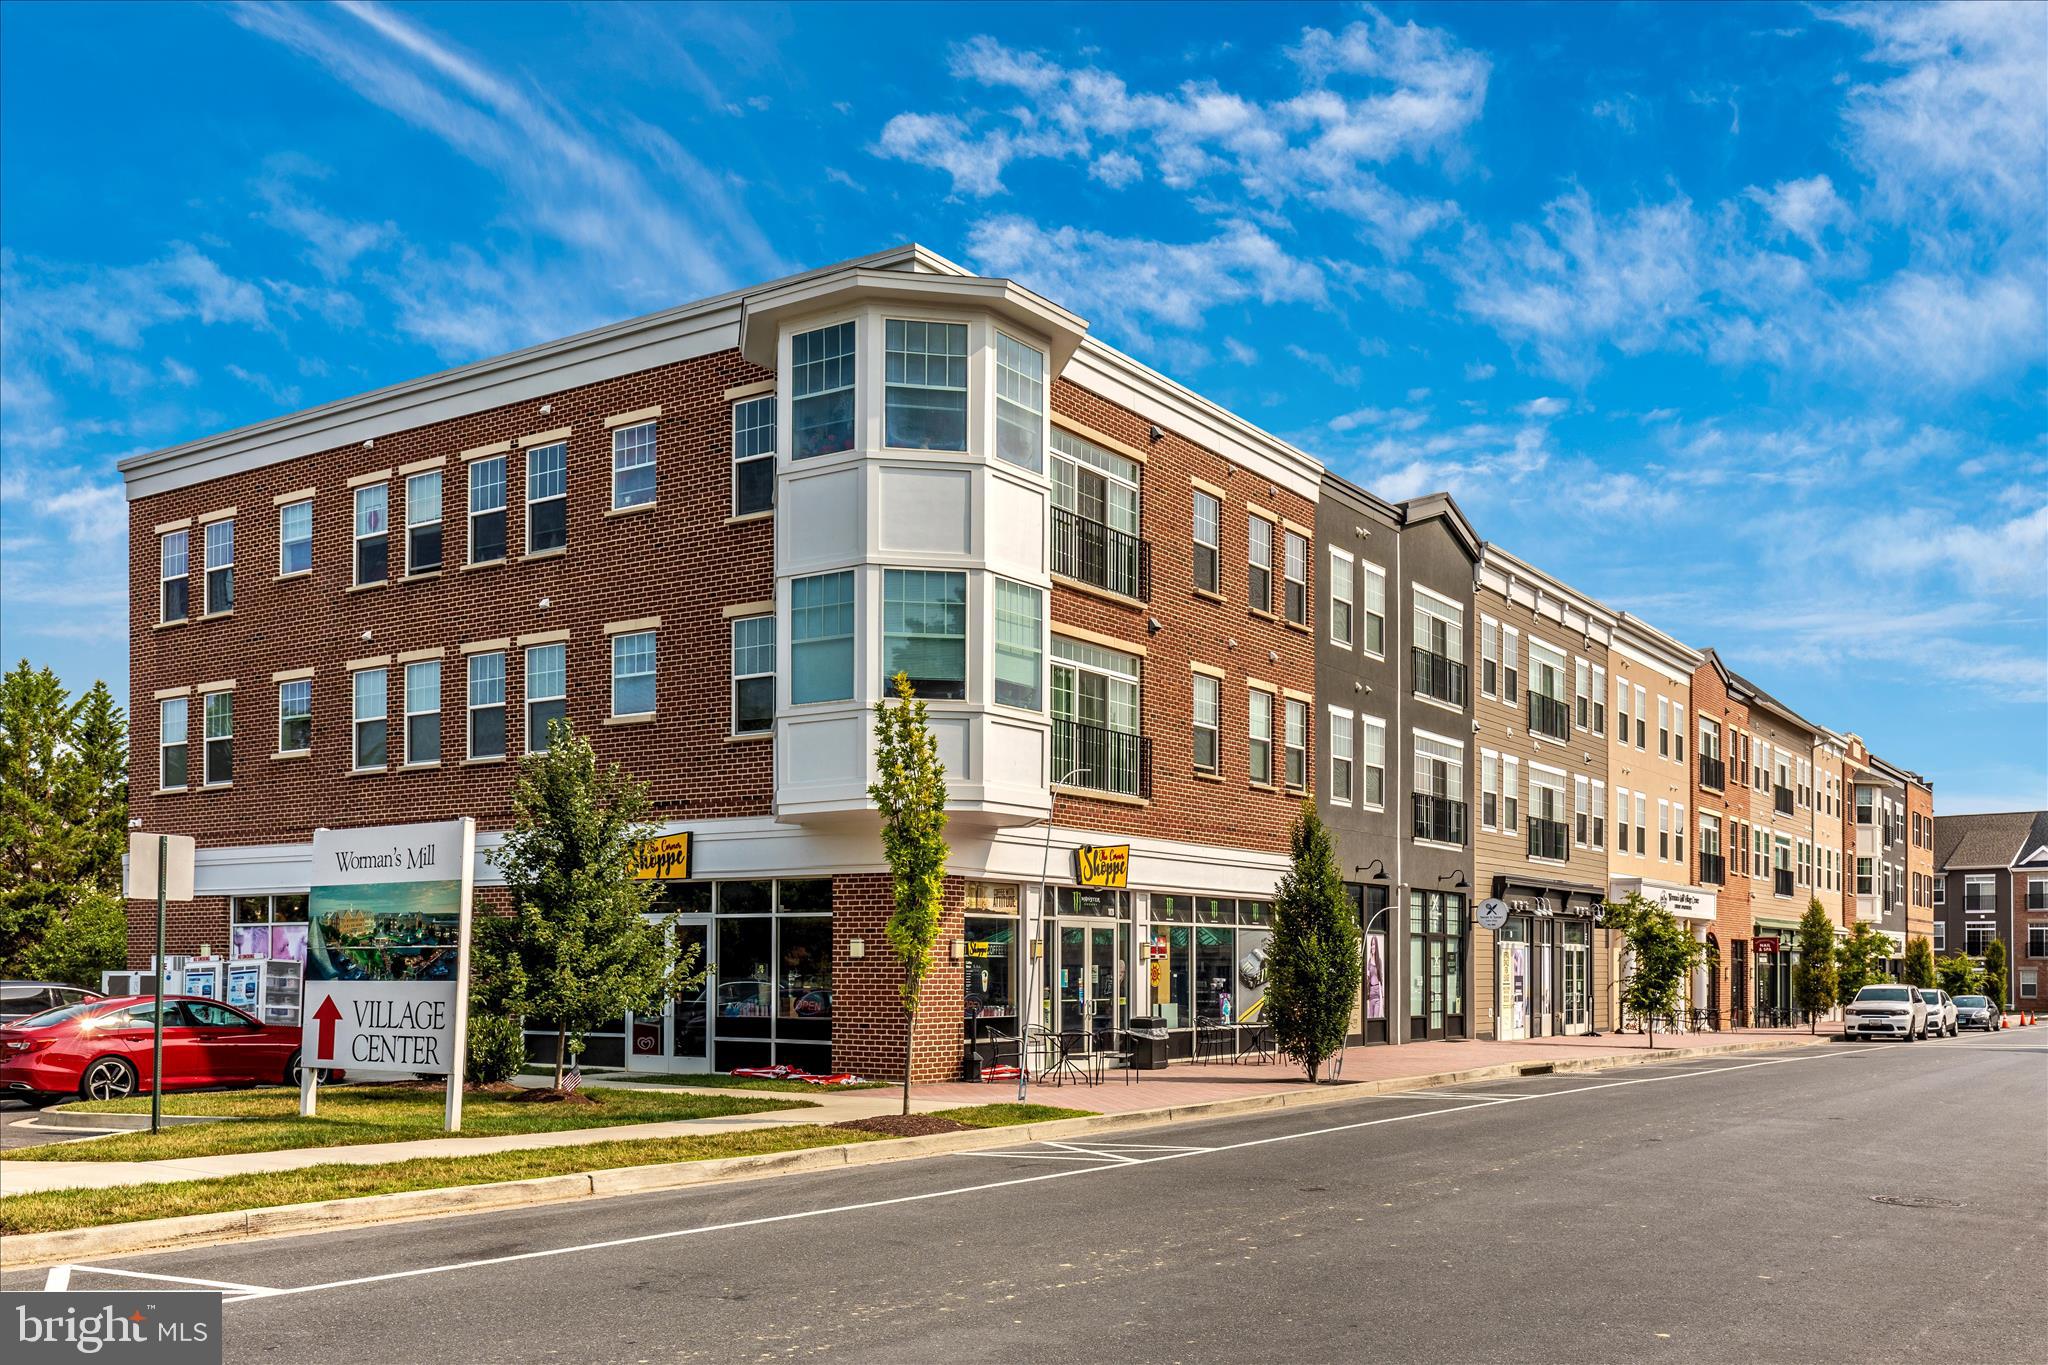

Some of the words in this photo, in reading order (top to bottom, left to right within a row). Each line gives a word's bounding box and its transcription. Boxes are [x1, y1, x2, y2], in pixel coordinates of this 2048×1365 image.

[335, 847, 402, 872] Worman's
[407, 844, 435, 870] Mill
[661, 839, 682, 852] Corner
[1084, 847, 1126, 886] Shoppe
[352, 1000, 446, 1030] VILLAGE
[352, 1034, 440, 1065] CENTER
